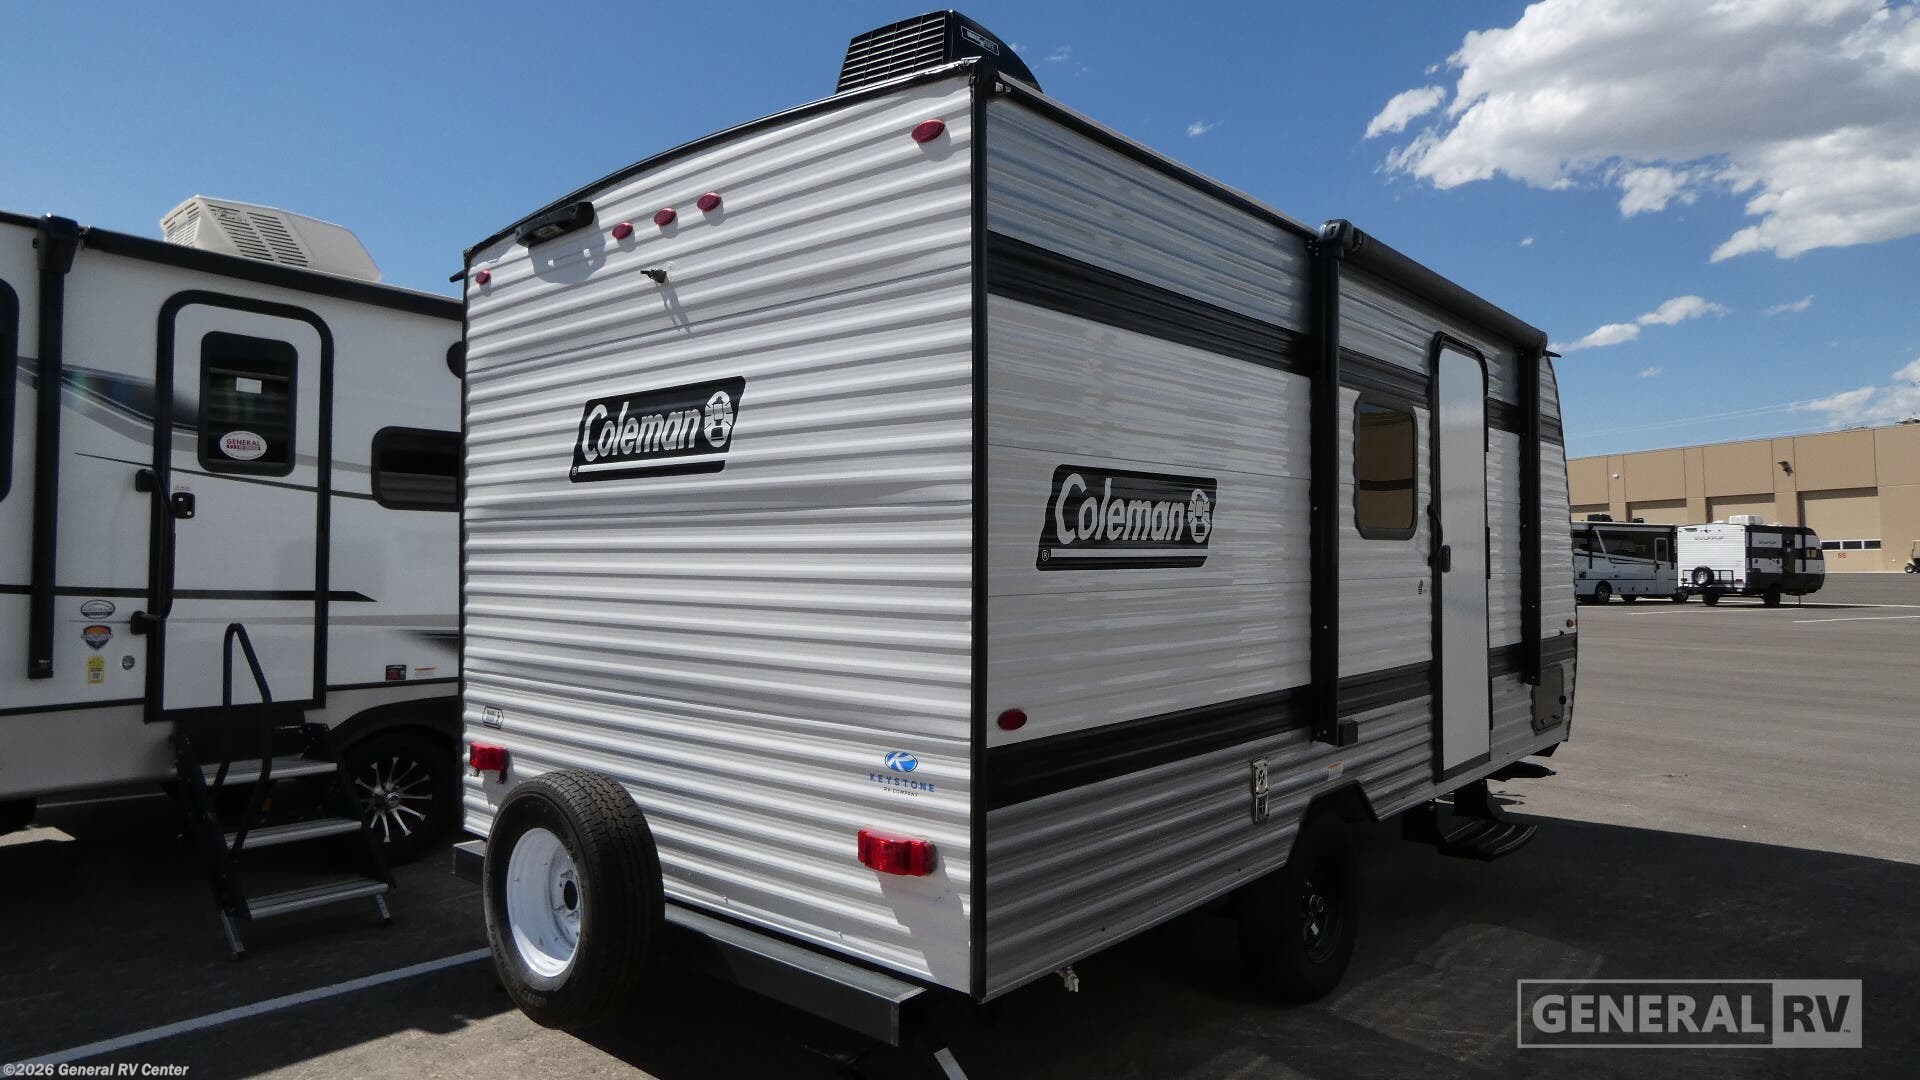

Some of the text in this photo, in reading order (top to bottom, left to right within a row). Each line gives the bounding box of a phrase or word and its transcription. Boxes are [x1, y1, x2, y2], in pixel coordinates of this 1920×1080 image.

[582, 401, 701, 462] Coleman
[1055, 473, 1184, 544] Coleman
[869, 772, 935, 792] KEYSTONE
